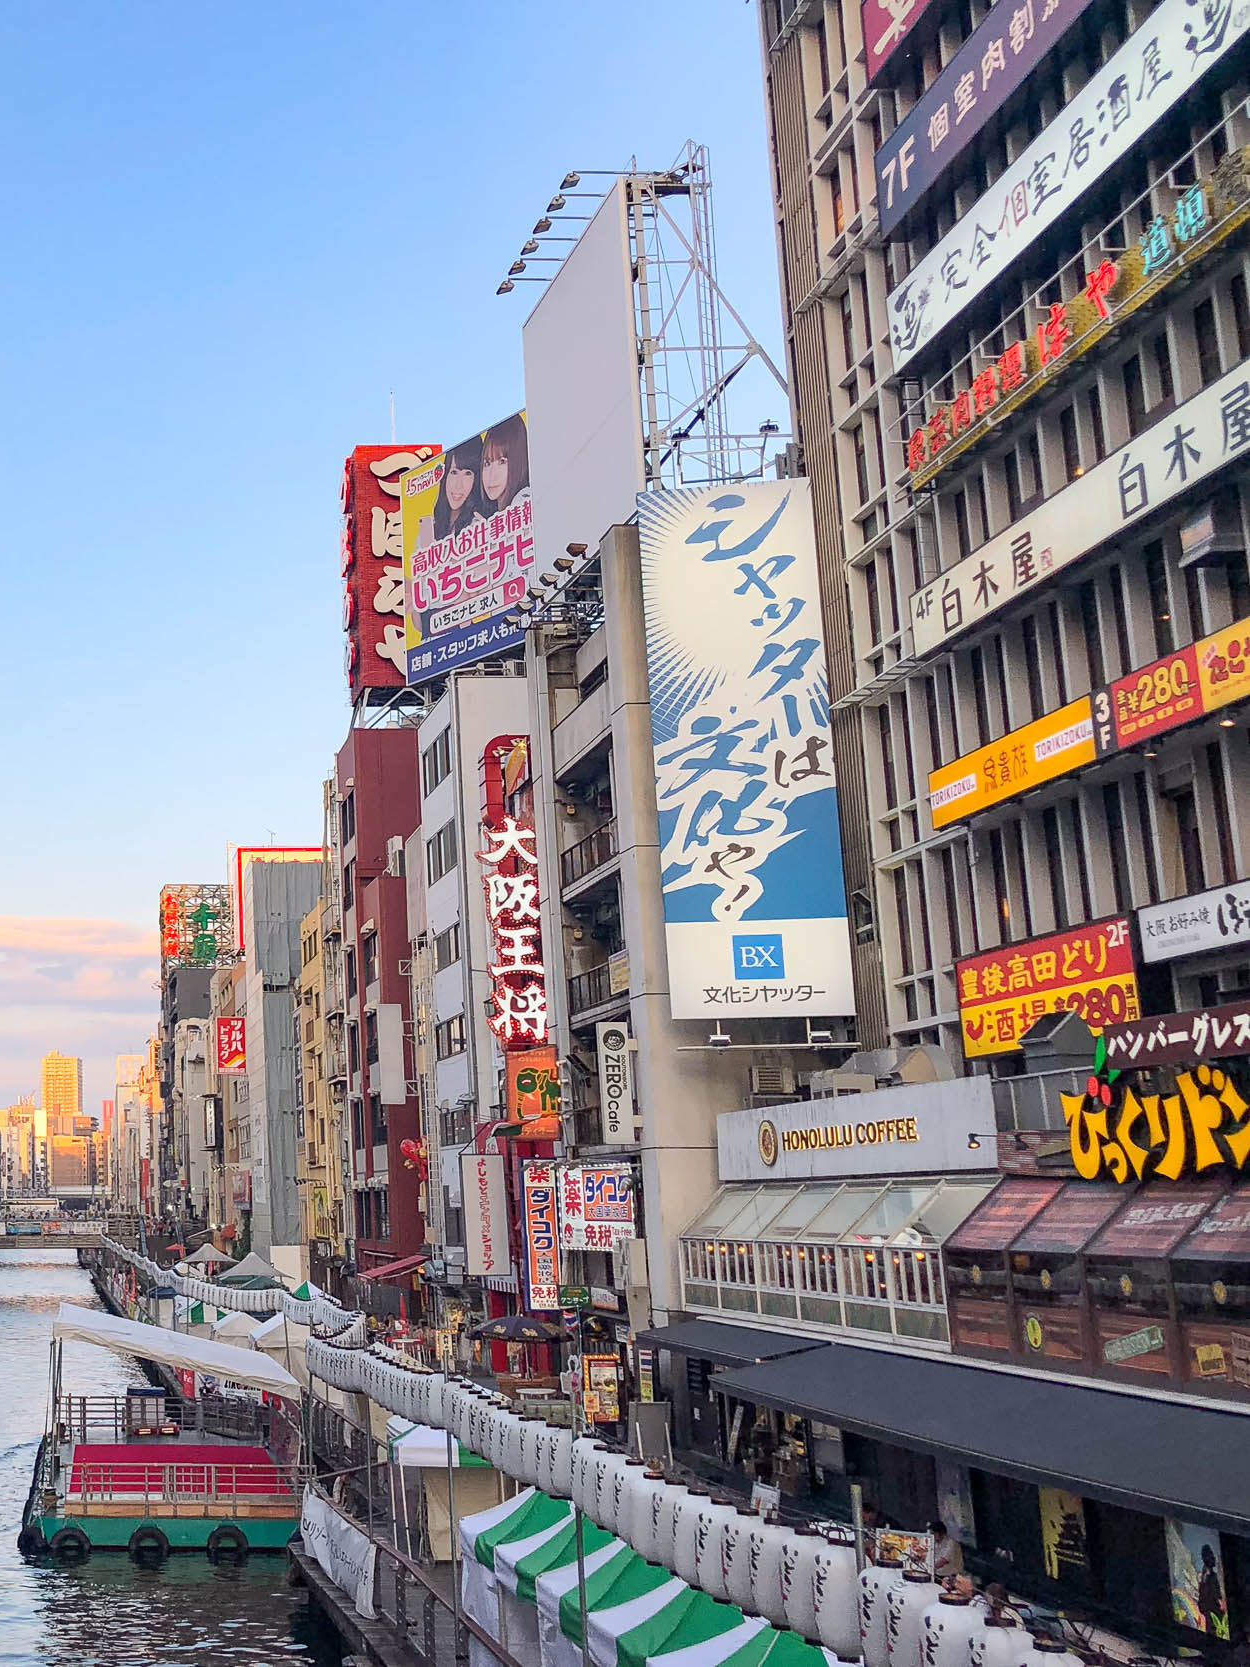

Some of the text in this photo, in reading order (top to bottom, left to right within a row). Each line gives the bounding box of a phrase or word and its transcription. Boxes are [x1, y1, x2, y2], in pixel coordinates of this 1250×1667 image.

[882, 135, 916, 209] 7F
[940, 36, 1172, 303] 完全個室居酒屋
[1139, 181, 1207, 277] 道頓
[1118, 381, 1250, 519] 白木屋
[915, 531, 1038, 634] 4F 白木屋
[433, 598, 498, 629] いちごナビ 求人
[684, 492, 830, 789] シャッターは
[1035, 727, 1087, 757] TORIKIZOKU
[1095, 692, 1112, 750] 3F
[930, 780, 972, 807] TORIKIZOKU
[188, 903, 217, 960] 千房
[475, 815, 548, 1043] 大阪王将
[1145, 919, 1167, 938] 大阪
[1168, 906, 1212, 930] お好み焼
[739, 944, 775, 968] BX
[960, 935, 1108, 1003] 豊後高田どり
[1106, 920, 1129, 948] 2F
[219, 1025, 230, 1061] ドラッグ
[230, 1019, 244, 1052] ツルハ
[990, 999, 1048, 1044] 酒場
[605, 1054, 622, 1098] ZERO
[782, 1116, 919, 1151] HONOLULU COFFEE
[528, 1163, 550, 1183] 薬
[563, 1166, 582, 1217] 薬
[584, 1174, 629, 1203] ダイコク
[530, 1188, 553, 1250] ダイコク
[584, 1223, 613, 1247] 免税
